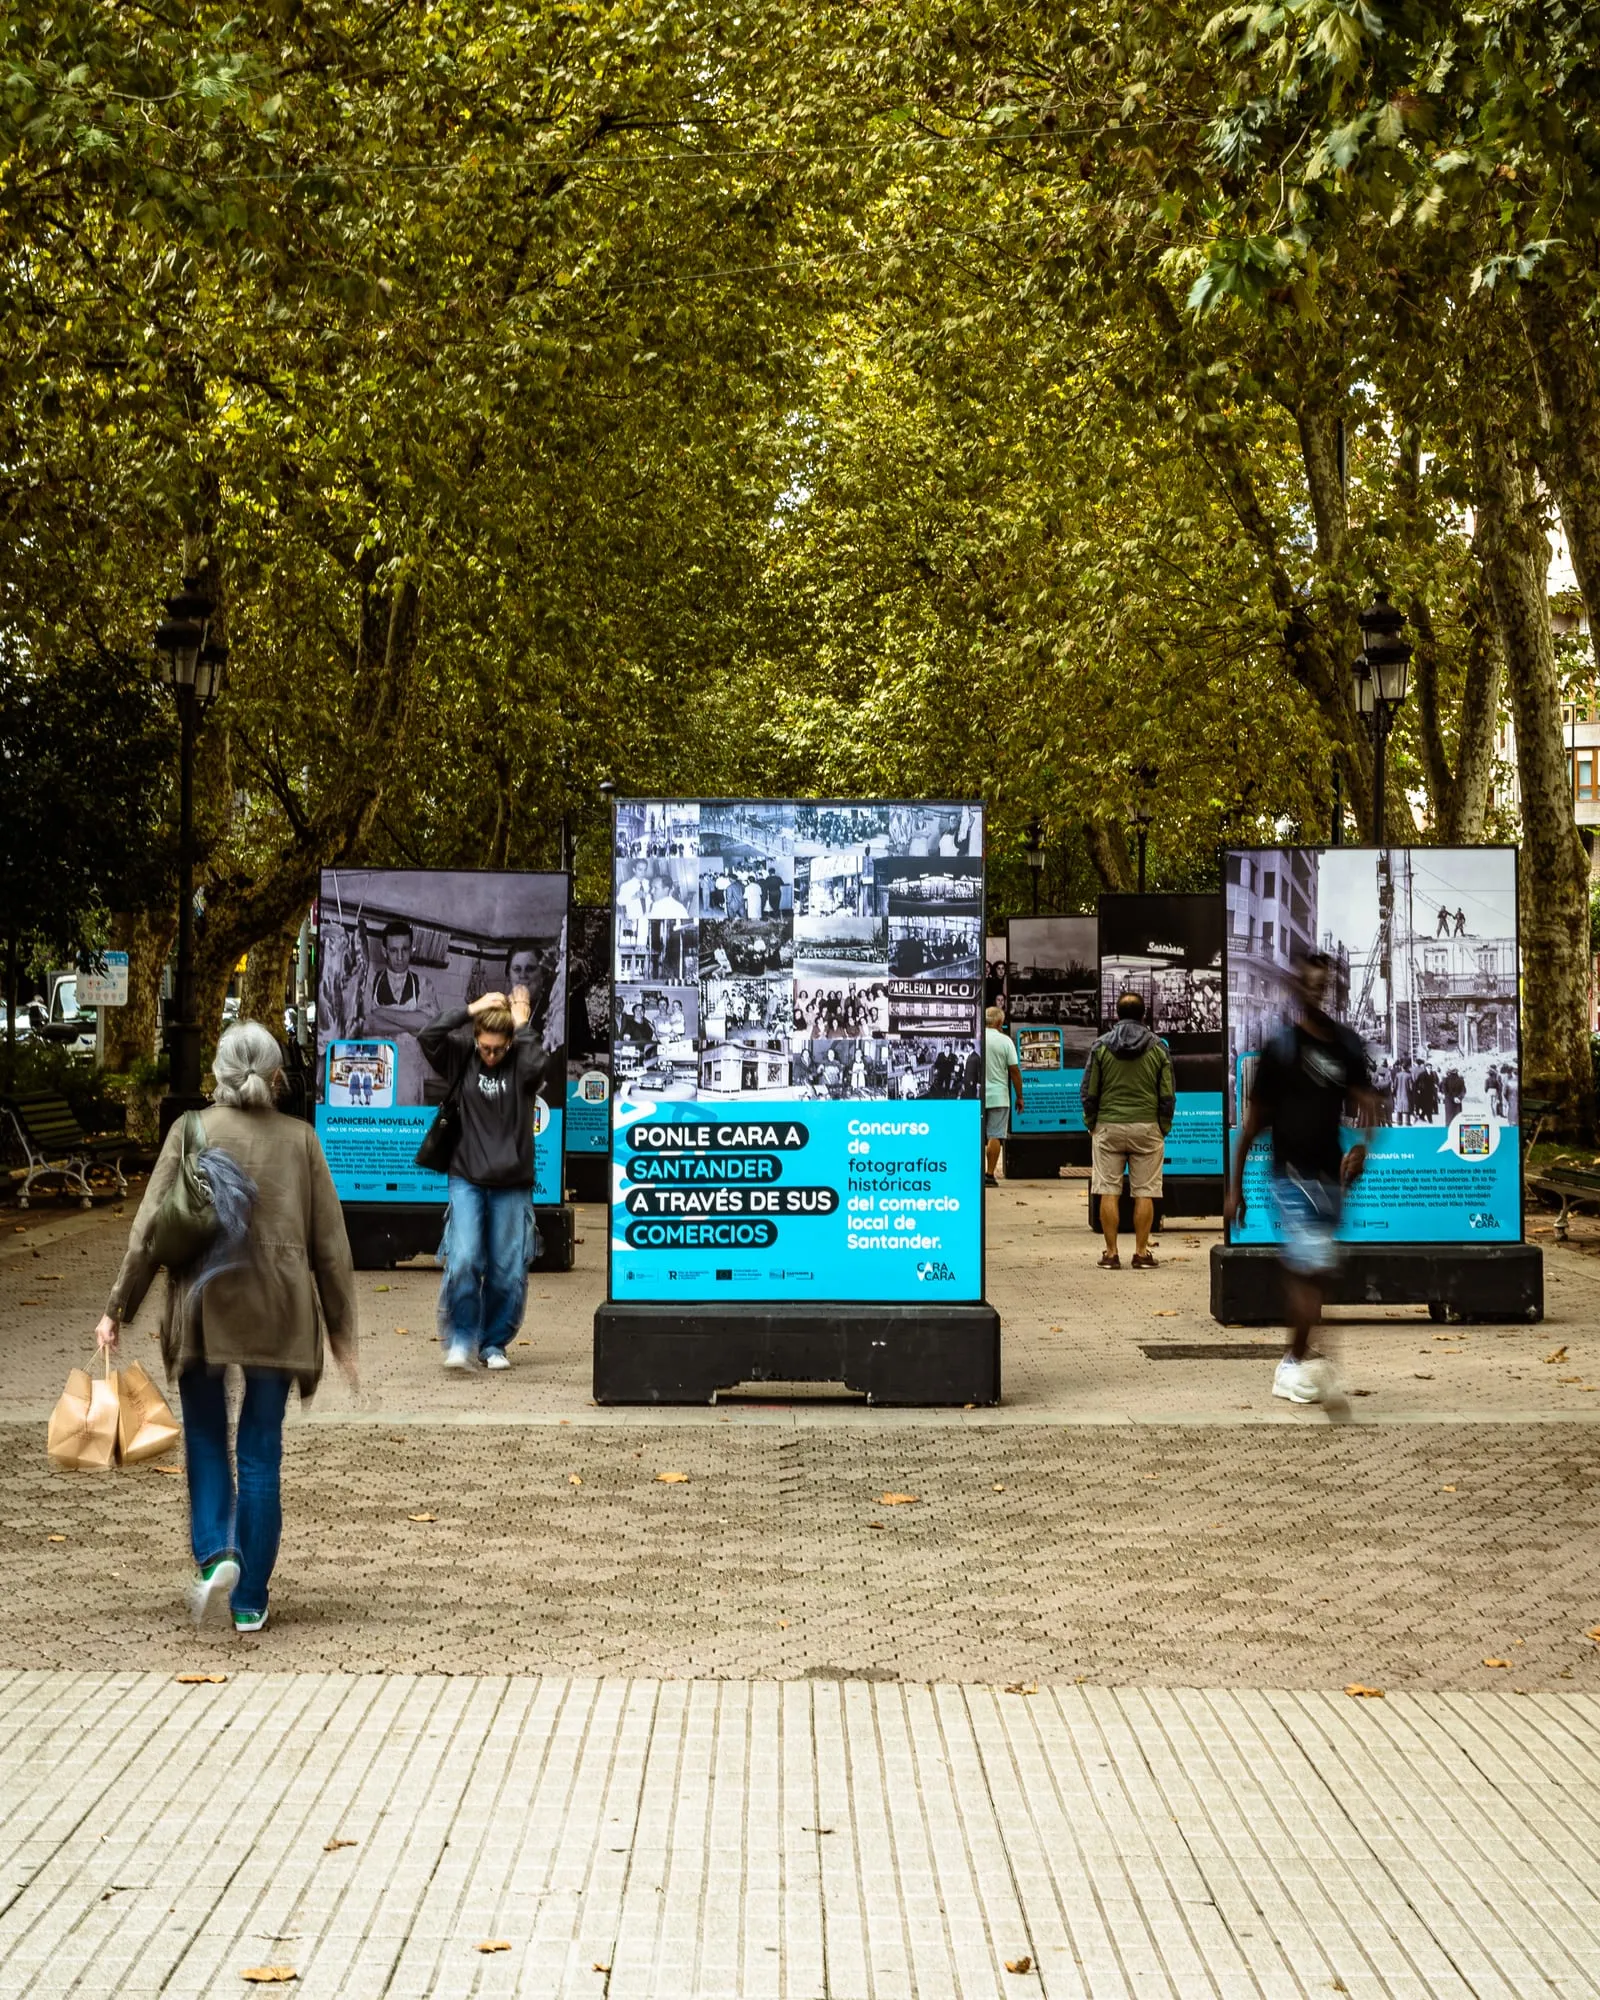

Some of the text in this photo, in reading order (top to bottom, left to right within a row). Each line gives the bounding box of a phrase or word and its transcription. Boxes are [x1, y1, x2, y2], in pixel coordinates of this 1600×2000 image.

[935, 983, 970, 997] PICO
[326, 1116, 425, 1126] CARNICERÍA MOVELLÁN
[847, 1119, 930, 1136] Concurso
[633, 1124, 801, 1148] PONLE CARA A
[847, 1138, 870, 1155] de
[632, 1158, 774, 1180] SANTANDER
[847, 1157, 948, 1177] fotografías
[847, 1176, 932, 1193] históricas
[632, 1187, 832, 1212] A TRAVÉS DE SUS
[847, 1195, 960, 1212] del comercio
[847, 1214, 916, 1231] local de
[632, 1223, 769, 1245] COMERCIOS
[847, 1232, 943, 1250] Santander.
[916, 1261, 949, 1273] CARA
